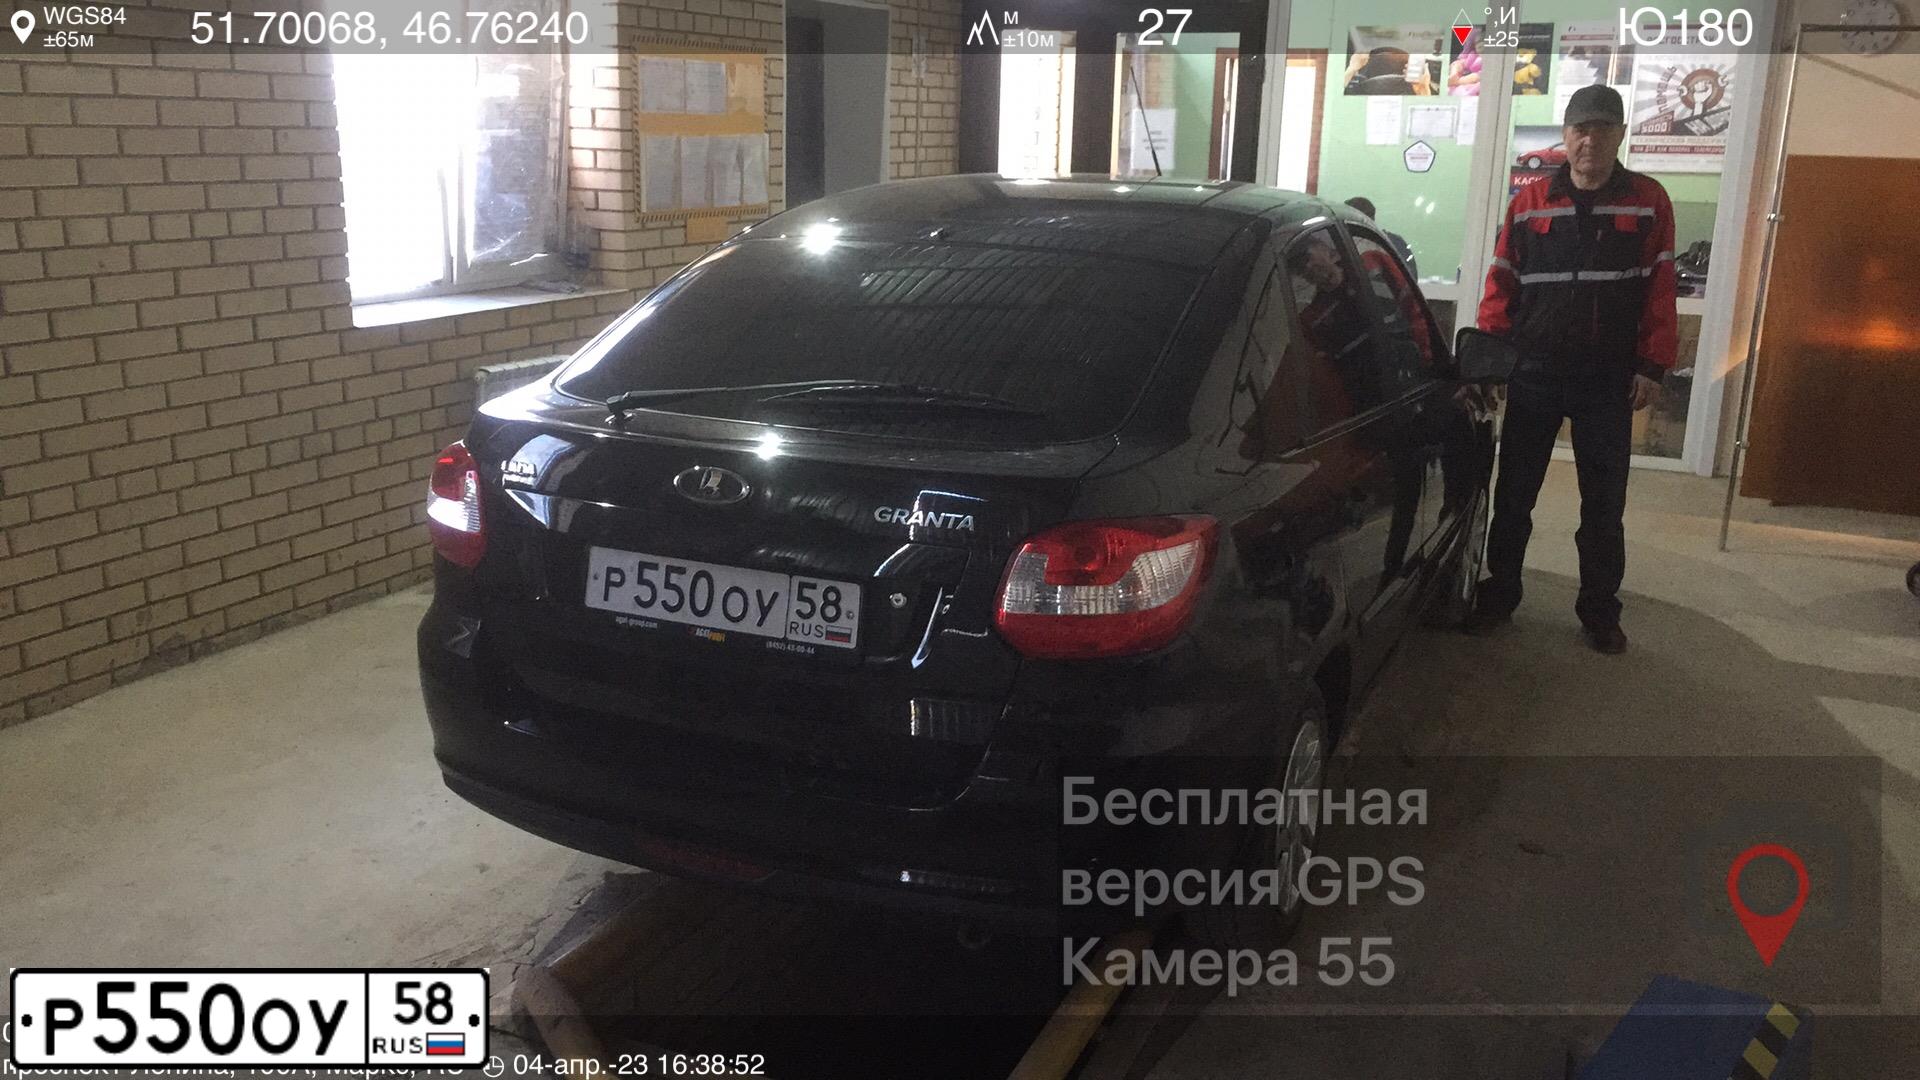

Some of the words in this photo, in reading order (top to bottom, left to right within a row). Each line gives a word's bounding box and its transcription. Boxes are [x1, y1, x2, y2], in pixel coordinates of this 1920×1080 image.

[873, 505, 975, 532] GRANTA
[603, 560, 780, 628] Р550ОУ
[795, 580, 842, 623] 58
[789, 621, 825, 639] RUS
